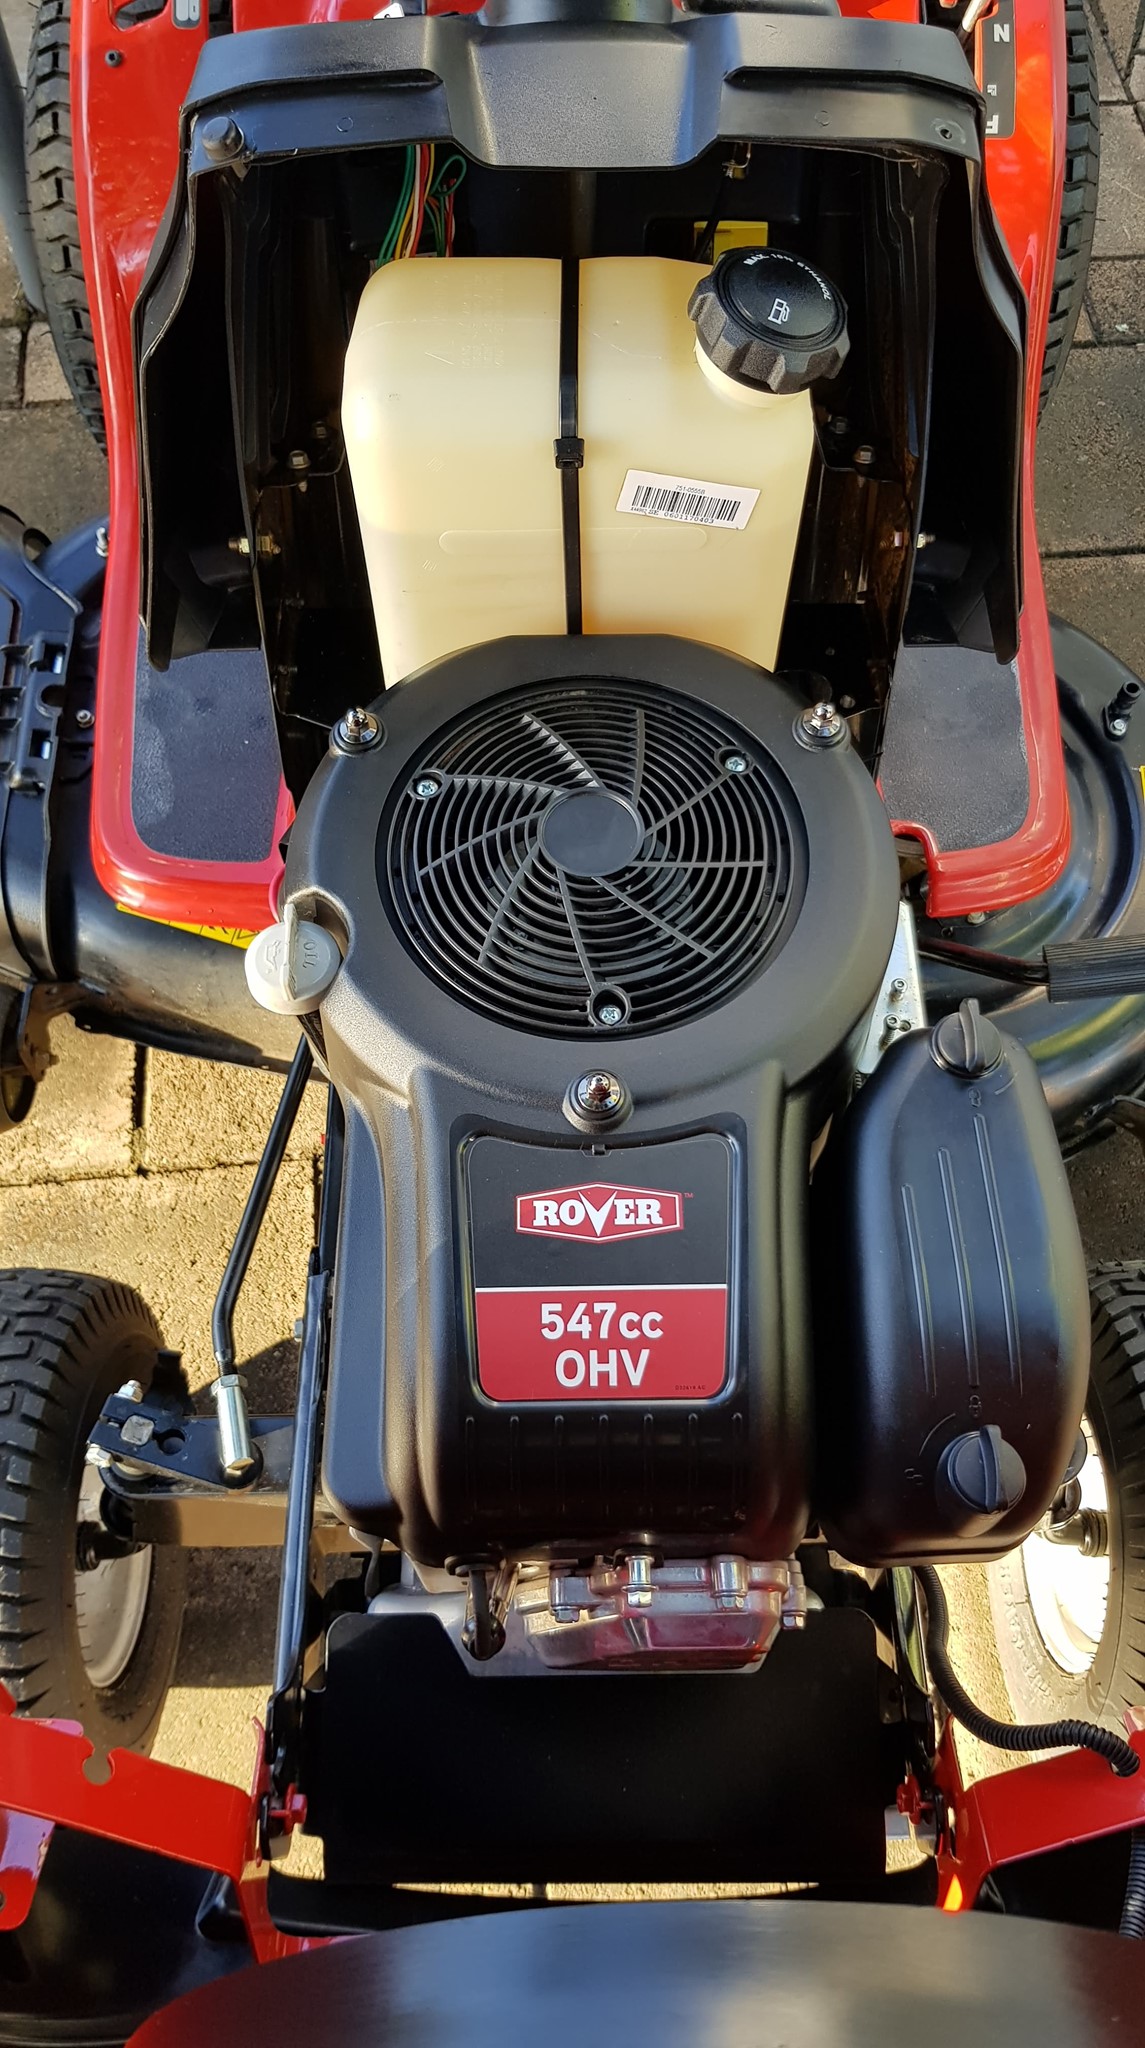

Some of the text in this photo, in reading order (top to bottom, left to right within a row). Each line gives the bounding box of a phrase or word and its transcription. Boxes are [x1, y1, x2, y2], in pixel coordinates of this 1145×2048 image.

[993, 24, 1010, 42] N
[985, 114, 999, 134] F
[797, 261, 832, 301] ETHANOL
[303, 940, 319, 969] OIL
[532, 1190, 664, 1237] ROVER
[540, 1302, 664, 1340] 547cc
[555, 1348, 651, 1388] OHV
